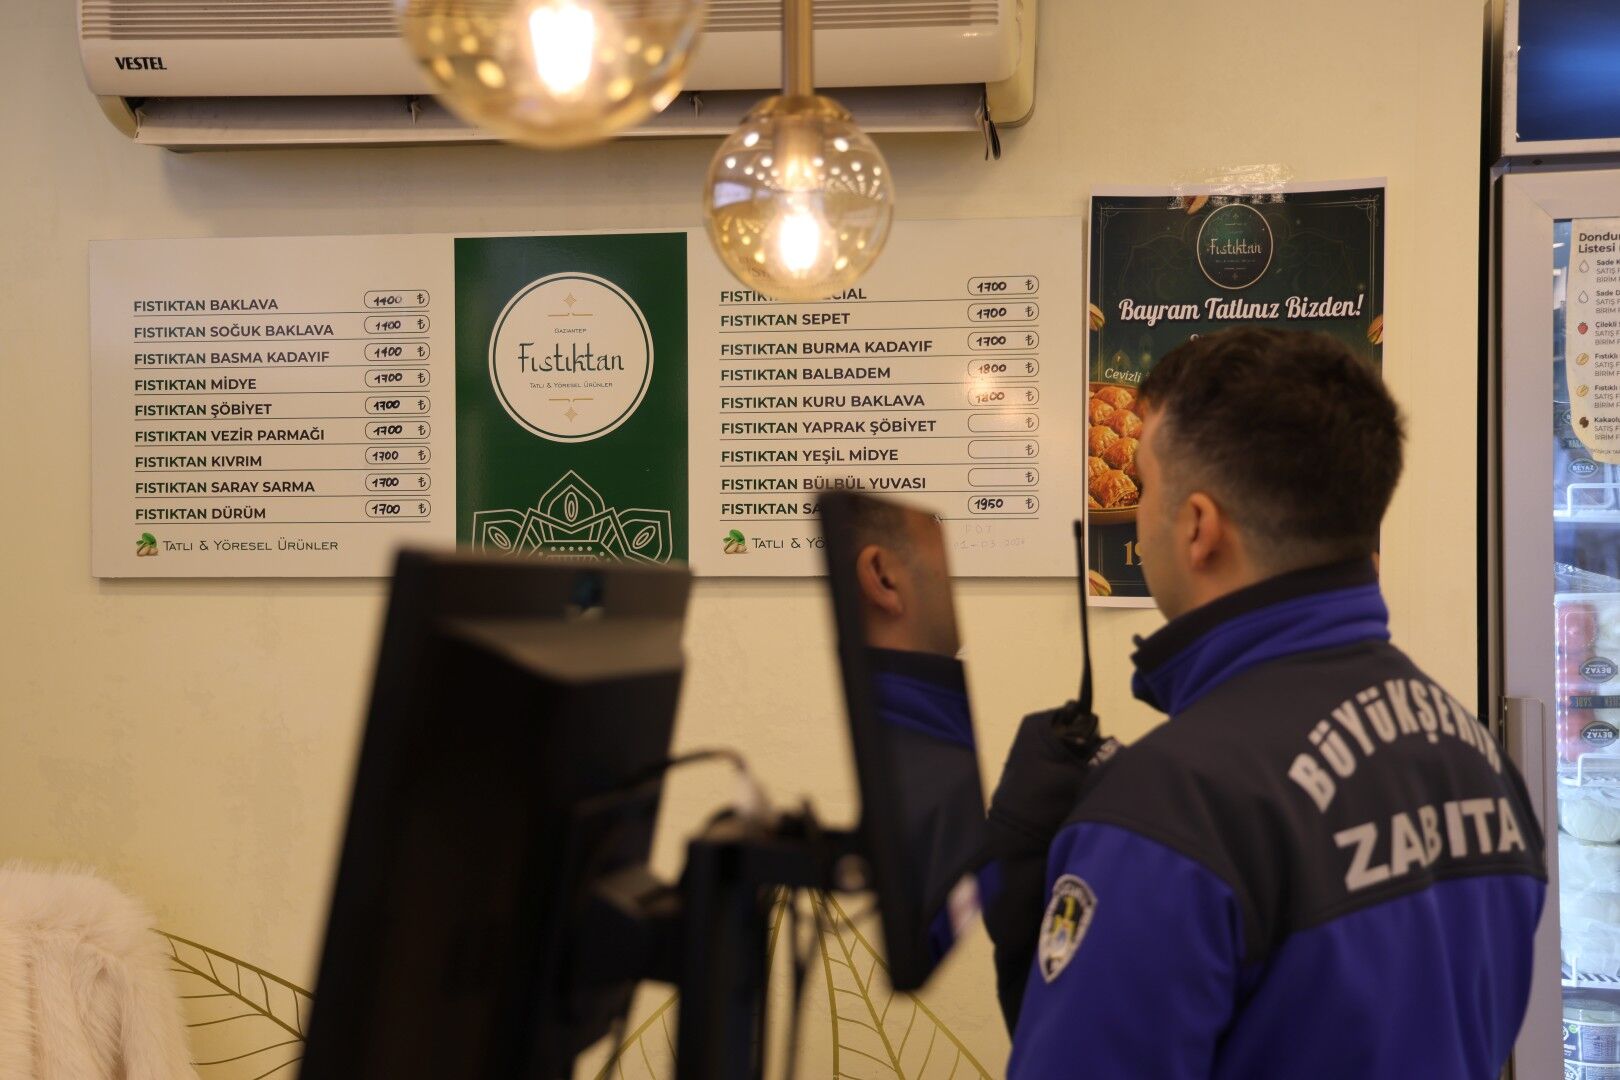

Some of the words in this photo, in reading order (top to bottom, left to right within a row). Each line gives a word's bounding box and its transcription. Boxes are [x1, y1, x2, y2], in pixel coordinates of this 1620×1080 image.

[114, 56, 167, 70] VESTEL
[1579, 243, 1615, 253] Listesi
[977, 281, 1007, 292] 1700
[134, 300, 206, 312] FISTIKTAN
[210, 299, 278, 311] BAKLAVA
[1118, 298, 1199, 326] Bayram
[1204, 297, 1280, 320] Tatlınız
[1285, 294, 1364, 318] Bizden!
[721, 315, 798, 327] FISTIKTAN
[802, 313, 850, 325] SEPET
[976, 307, 1007, 319] 1700
[134, 326, 206, 338] FISTIKTAN
[210, 324, 261, 337] SOĞUK
[265, 324, 334, 336] BAKLAVA
[721, 344, 798, 356] FISTIKTAN
[802, 342, 860, 355] BURMA
[865, 340, 932, 353] KADAYIF
[976, 335, 1006, 347] 1700
[134, 353, 206, 365] FISTIKTAN
[211, 352, 262, 364] BASMA
[267, 351, 330, 363] KADAYIF
[517, 342, 625, 374] Fıstıktan
[374, 372, 402, 384] 1700
[721, 369, 798, 382] FISTIKTAN
[803, 367, 890, 380] BALBADEM
[1104, 367, 1142, 383] Cevizli
[135, 379, 206, 391] FISTIKTAN
[211, 376, 257, 390] MİDYE
[373, 399, 400, 410] 1700
[721, 397, 798, 409] FISTIKTAN
[803, 395, 847, 408] KURU
[851, 395, 924, 407] BAKLAVA
[135, 404, 206, 416] FISTIKTAN
[211, 401, 272, 419] ŞÖBİYET
[373, 424, 403, 435] 1700
[721, 422, 798, 434] FISTIKTAN
[802, 422, 865, 433] YAPRAK
[870, 418, 936, 436] ŞÖBİYET
[135, 431, 206, 442] FISTIKTAN
[211, 428, 253, 441] VEZİR
[257, 427, 324, 441] PARMAĞI
[135, 456, 207, 468] FISTIKTAN
[211, 456, 262, 467] KIVRIM
[372, 450, 399, 461] 1700
[721, 451, 798, 463] FISTIKTAN
[802, 447, 845, 465] YEŞİL
[849, 446, 898, 461] MİDYE
[135, 482, 207, 494] FISTIKTAN
[211, 482, 258, 493] SARAY
[262, 481, 315, 492] SARMA
[372, 477, 399, 488] 1700
[722, 479, 798, 490] FISTIKTAN
[803, 475, 865, 490] BÜLBÜL
[869, 477, 926, 489] YUVASI
[371, 504, 400, 515] 1700
[722, 503, 798, 515] FISTIKTAN
[974, 498, 1004, 510] 1950
[136, 509, 207, 520] FISTIKTAN
[211, 506, 266, 519] DÜRÜM
[163, 540, 193, 551] TATLI
[200, 540, 209, 551] &
[214, 538, 272, 551] YÖRESEL
[278, 537, 338, 550] ÜRÜNLER
[752, 538, 783, 549] TATLI
[791, 538, 801, 549] &
[1586, 731, 1613, 739] BEYAZ
[1333, 798, 1526, 892] ZABITA
